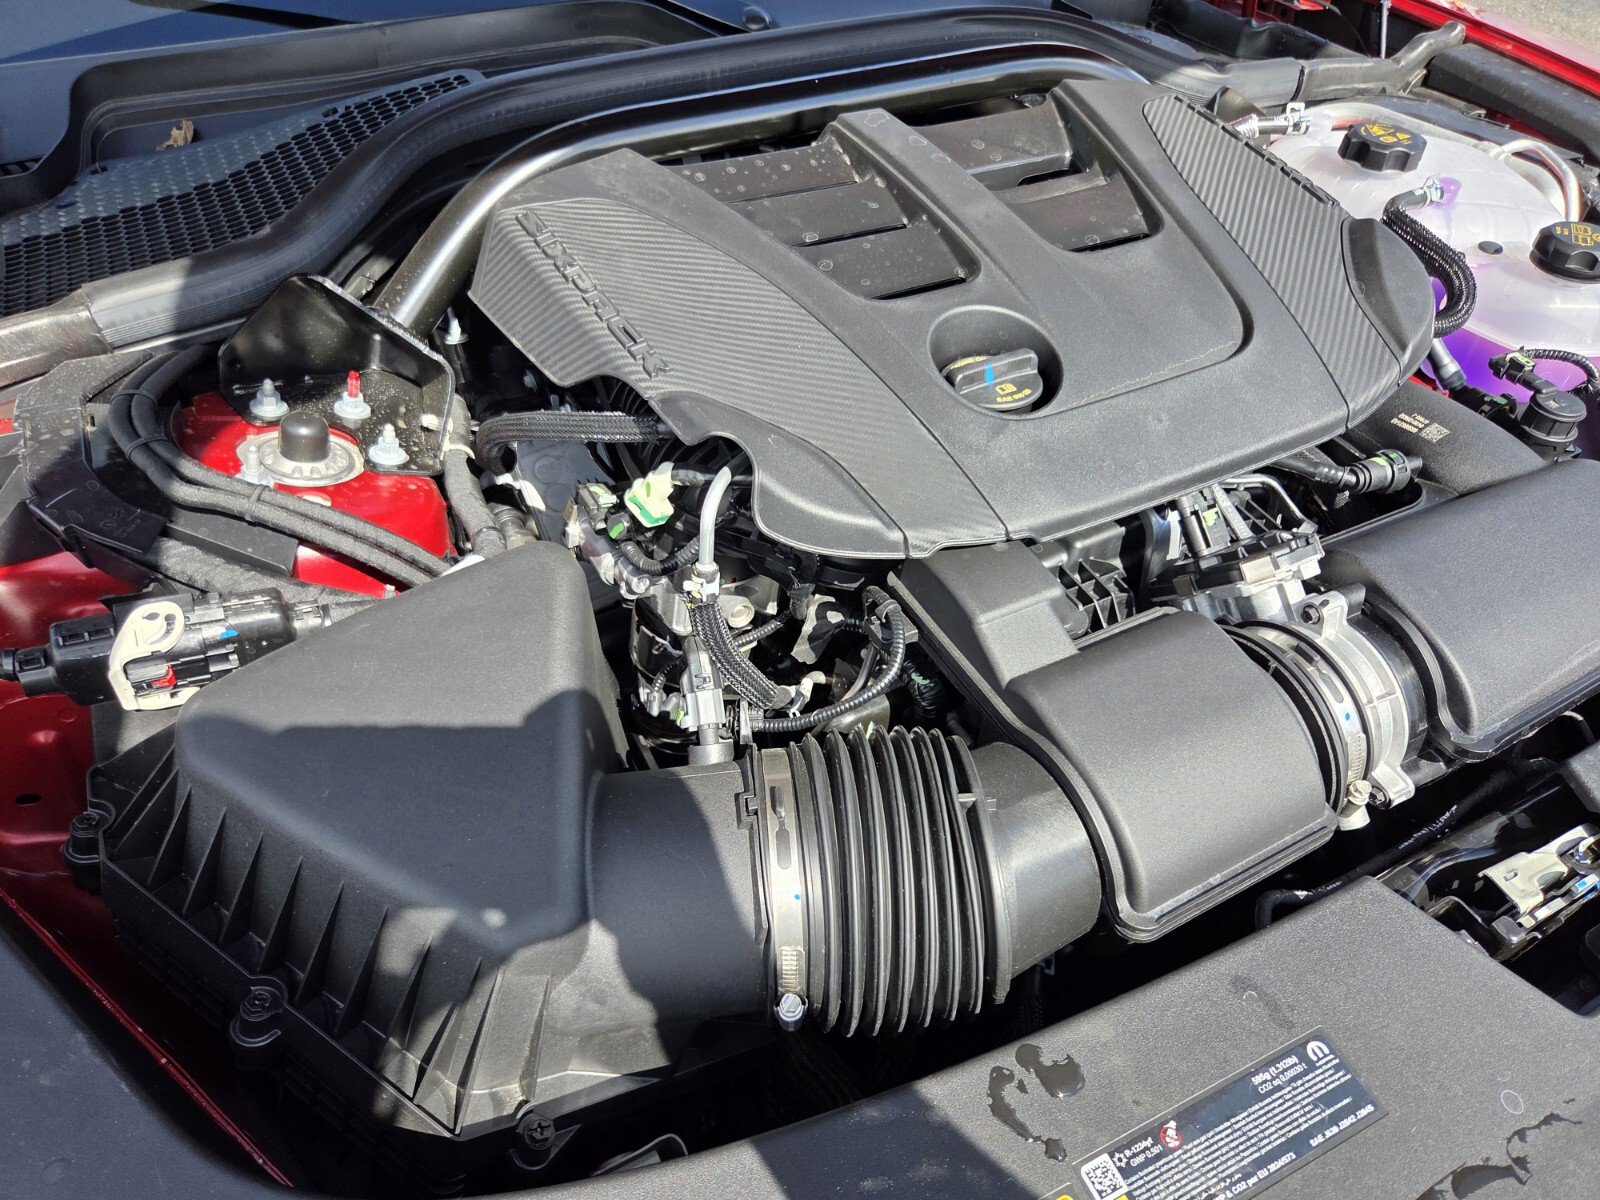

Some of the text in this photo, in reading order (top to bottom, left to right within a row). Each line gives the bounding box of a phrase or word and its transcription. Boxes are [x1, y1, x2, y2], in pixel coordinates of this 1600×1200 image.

[515, 210, 673, 381] SIXPACK
[1258, 1081, 1273, 1093] CO2
[1124, 1137, 1153, 1157] R-1234yf
[1309, 1134, 1325, 1146] SAE
[1130, 1153, 1145, 1166] GWP
[1231, 1181, 1247, 1194] CO2
[1246, 1175, 1258, 1187] per
[1257, 1168, 1268, 1178] EU
